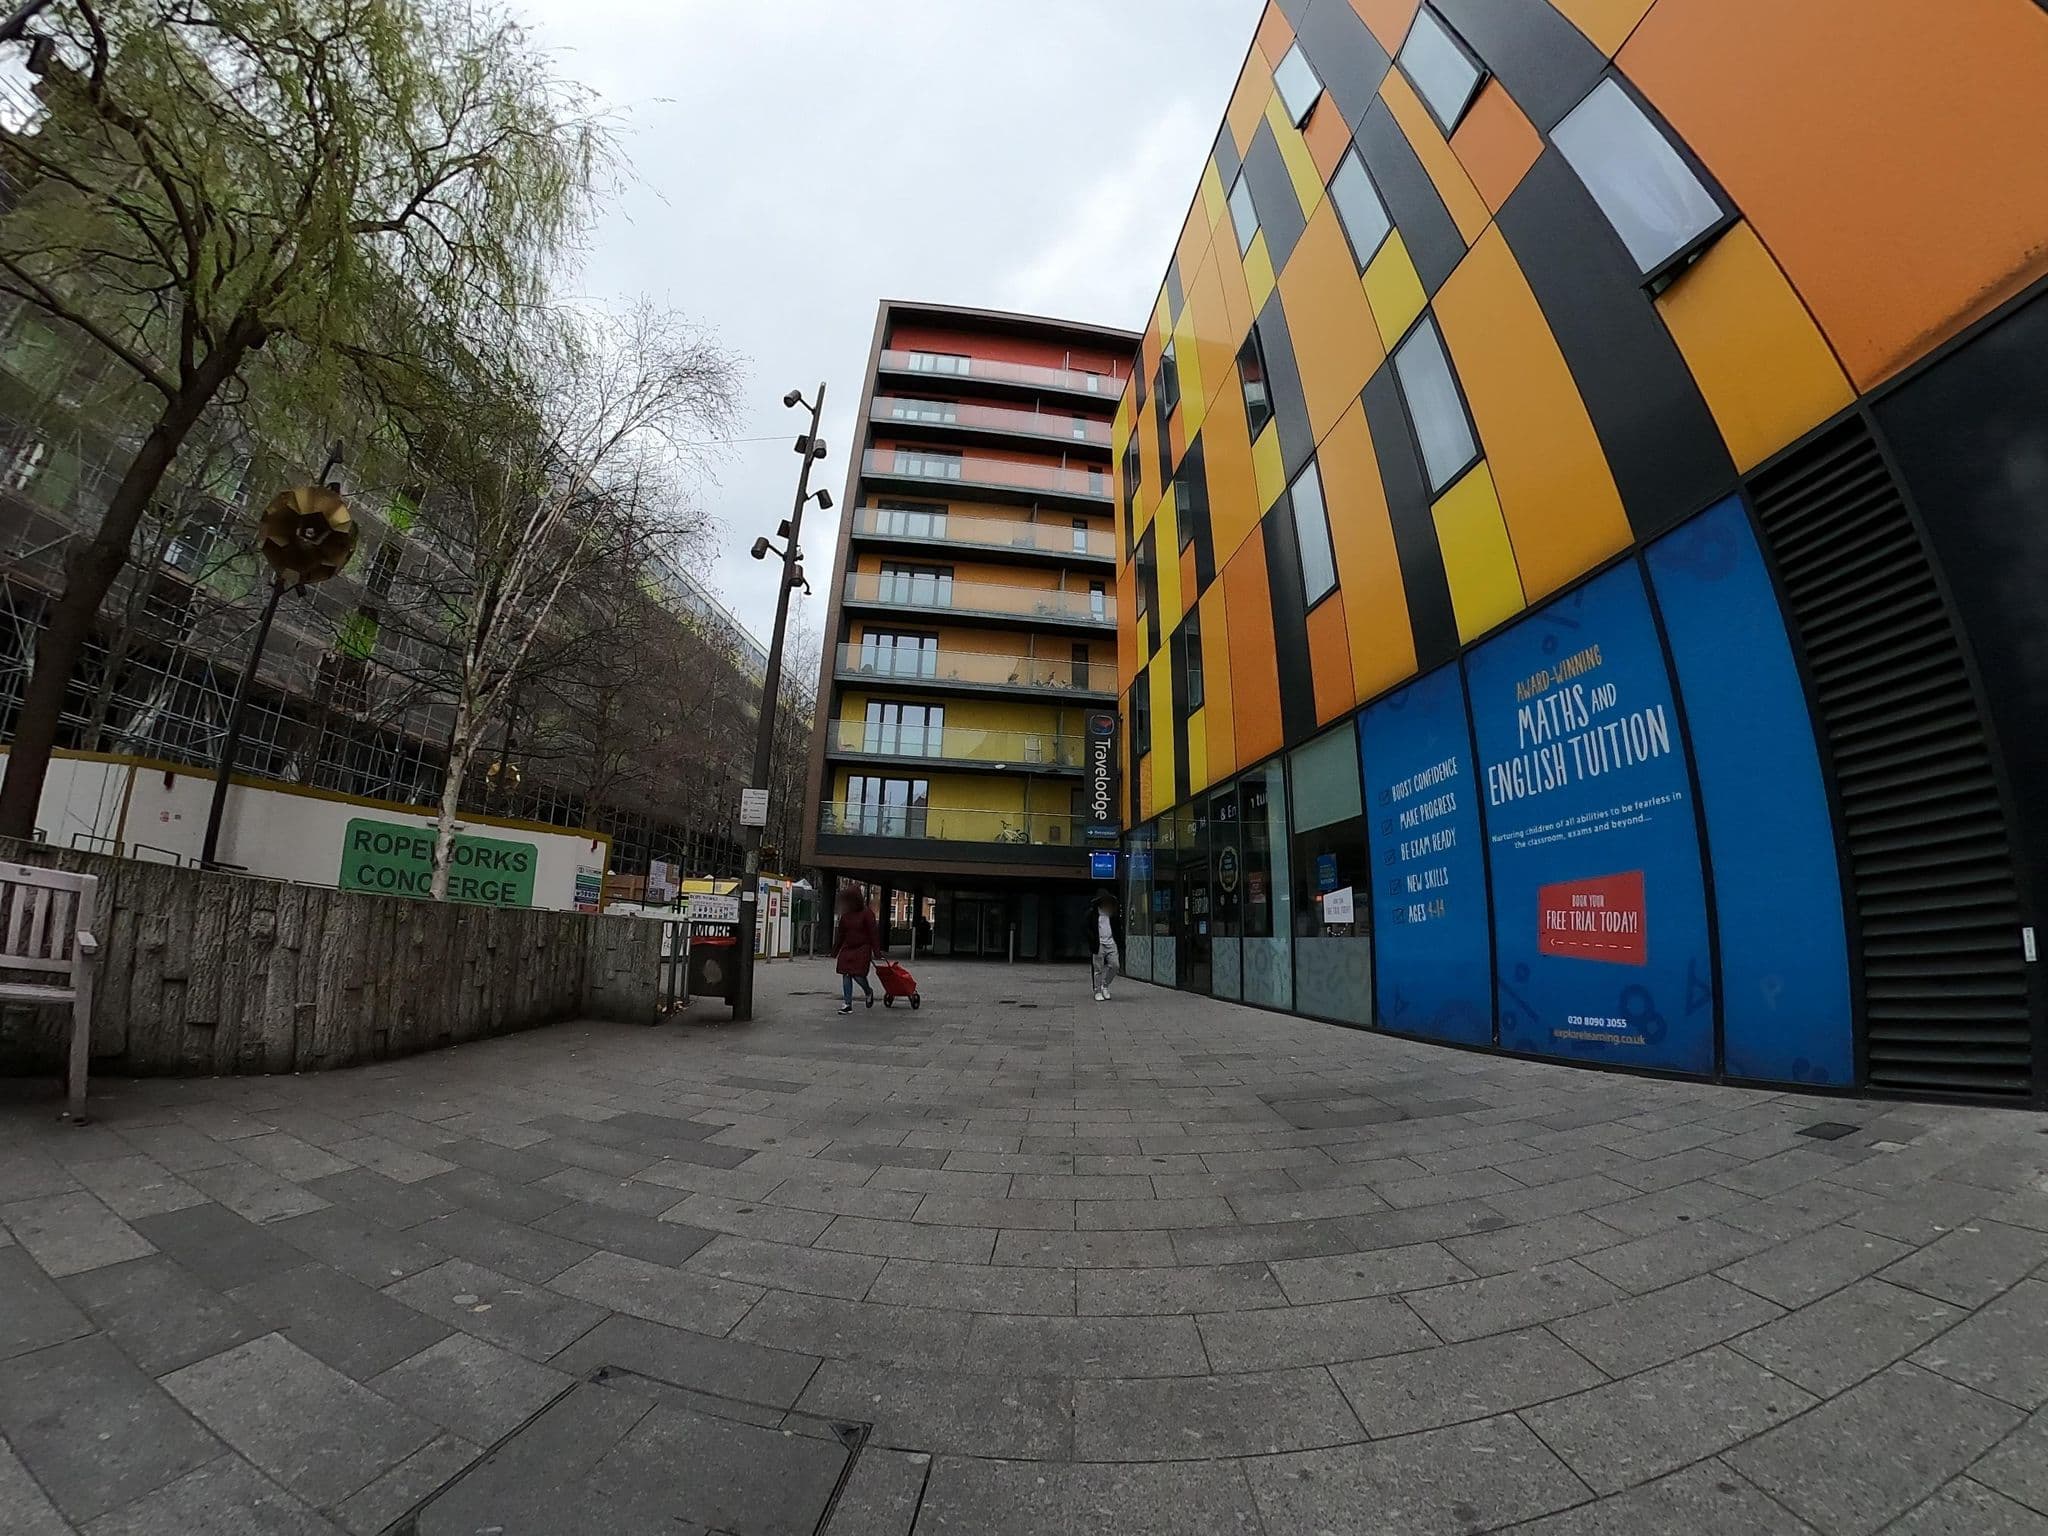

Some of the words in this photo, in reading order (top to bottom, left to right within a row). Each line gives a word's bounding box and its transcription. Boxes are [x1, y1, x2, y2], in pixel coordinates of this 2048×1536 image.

[1516, 644, 1602, 702] AWARD-WINNING
[1518, 684, 1590, 749] MATHS
[1592, 683, 1617, 714] AND
[1488, 742, 1568, 806] ENGLISH
[1567, 704, 1671, 780] TUITION
[1091, 738, 1111, 820] Travelodge
[1391, 778, 1412, 802] BOOST
[1413, 756, 1459, 793] CONFIDENCE
[1400, 808, 1420, 831] MAKE
[1420, 792, 1457, 822] PROGRESS
[1491, 830, 1524, 843] Nurturing
[1525, 823, 1554, 836] children
[1555, 819, 1565, 829] of
[1565, 817, 1576, 827] all
[1576, 809, 1609, 824] abilities
[1610, 807, 1620, 816] to
[1622, 804, 1633, 814] be
[1634, 796, 1671, 810] fearless
[1672, 791, 1682, 801] in
[1400, 842, 1410, 861] BE
[1410, 835, 1432, 859] EXAM
[1432, 828, 1456, 851] READY
[1514, 839, 1526, 849] the
[1527, 833, 1566, 847] classroom,
[1567, 827, 1593, 839] exams
[1593, 821, 1610, 833] and
[357, 863, 517, 904] CONCERGE
[1407, 873, 1423, 893] NEW
[1424, 867, 1449, 890] SKILLS
[1408, 903, 1427, 924] AGES
[1546, 910, 1567, 930] FREE
[1569, 911, 1597, 932] TRIAL
[1599, 911, 1638, 934] TODAY!
[1567, 1015, 1583, 1025] 020
[1583, 1016, 1605, 1027] 8090
[1606, 1018, 1627, 1028] 3055
